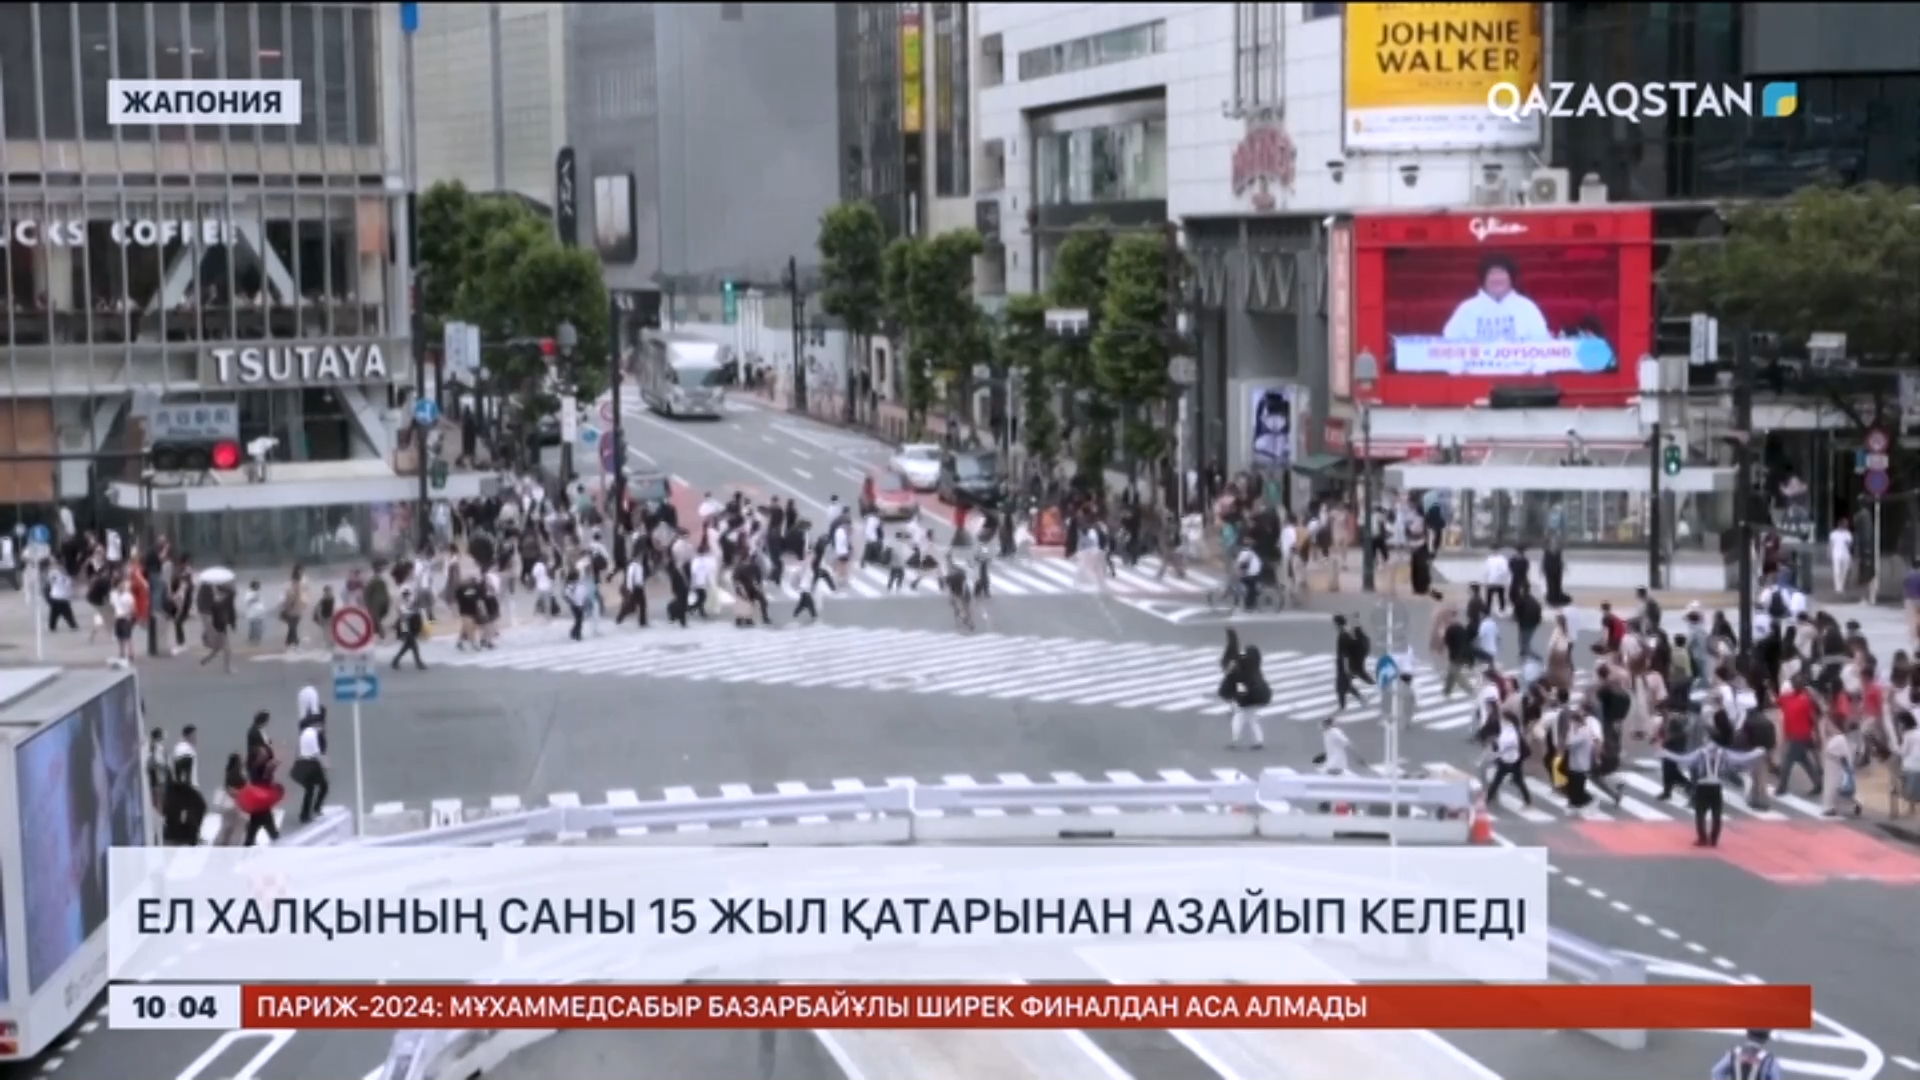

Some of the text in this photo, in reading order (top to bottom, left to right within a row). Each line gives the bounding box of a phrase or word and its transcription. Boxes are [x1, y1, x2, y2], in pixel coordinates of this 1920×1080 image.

[1376, 20, 1521, 46] JOHNNIE
[1376, 48, 1521, 73] WALKER
[0, 219, 85, 246] CKS
[213, 344, 387, 383] TSUTAYA
